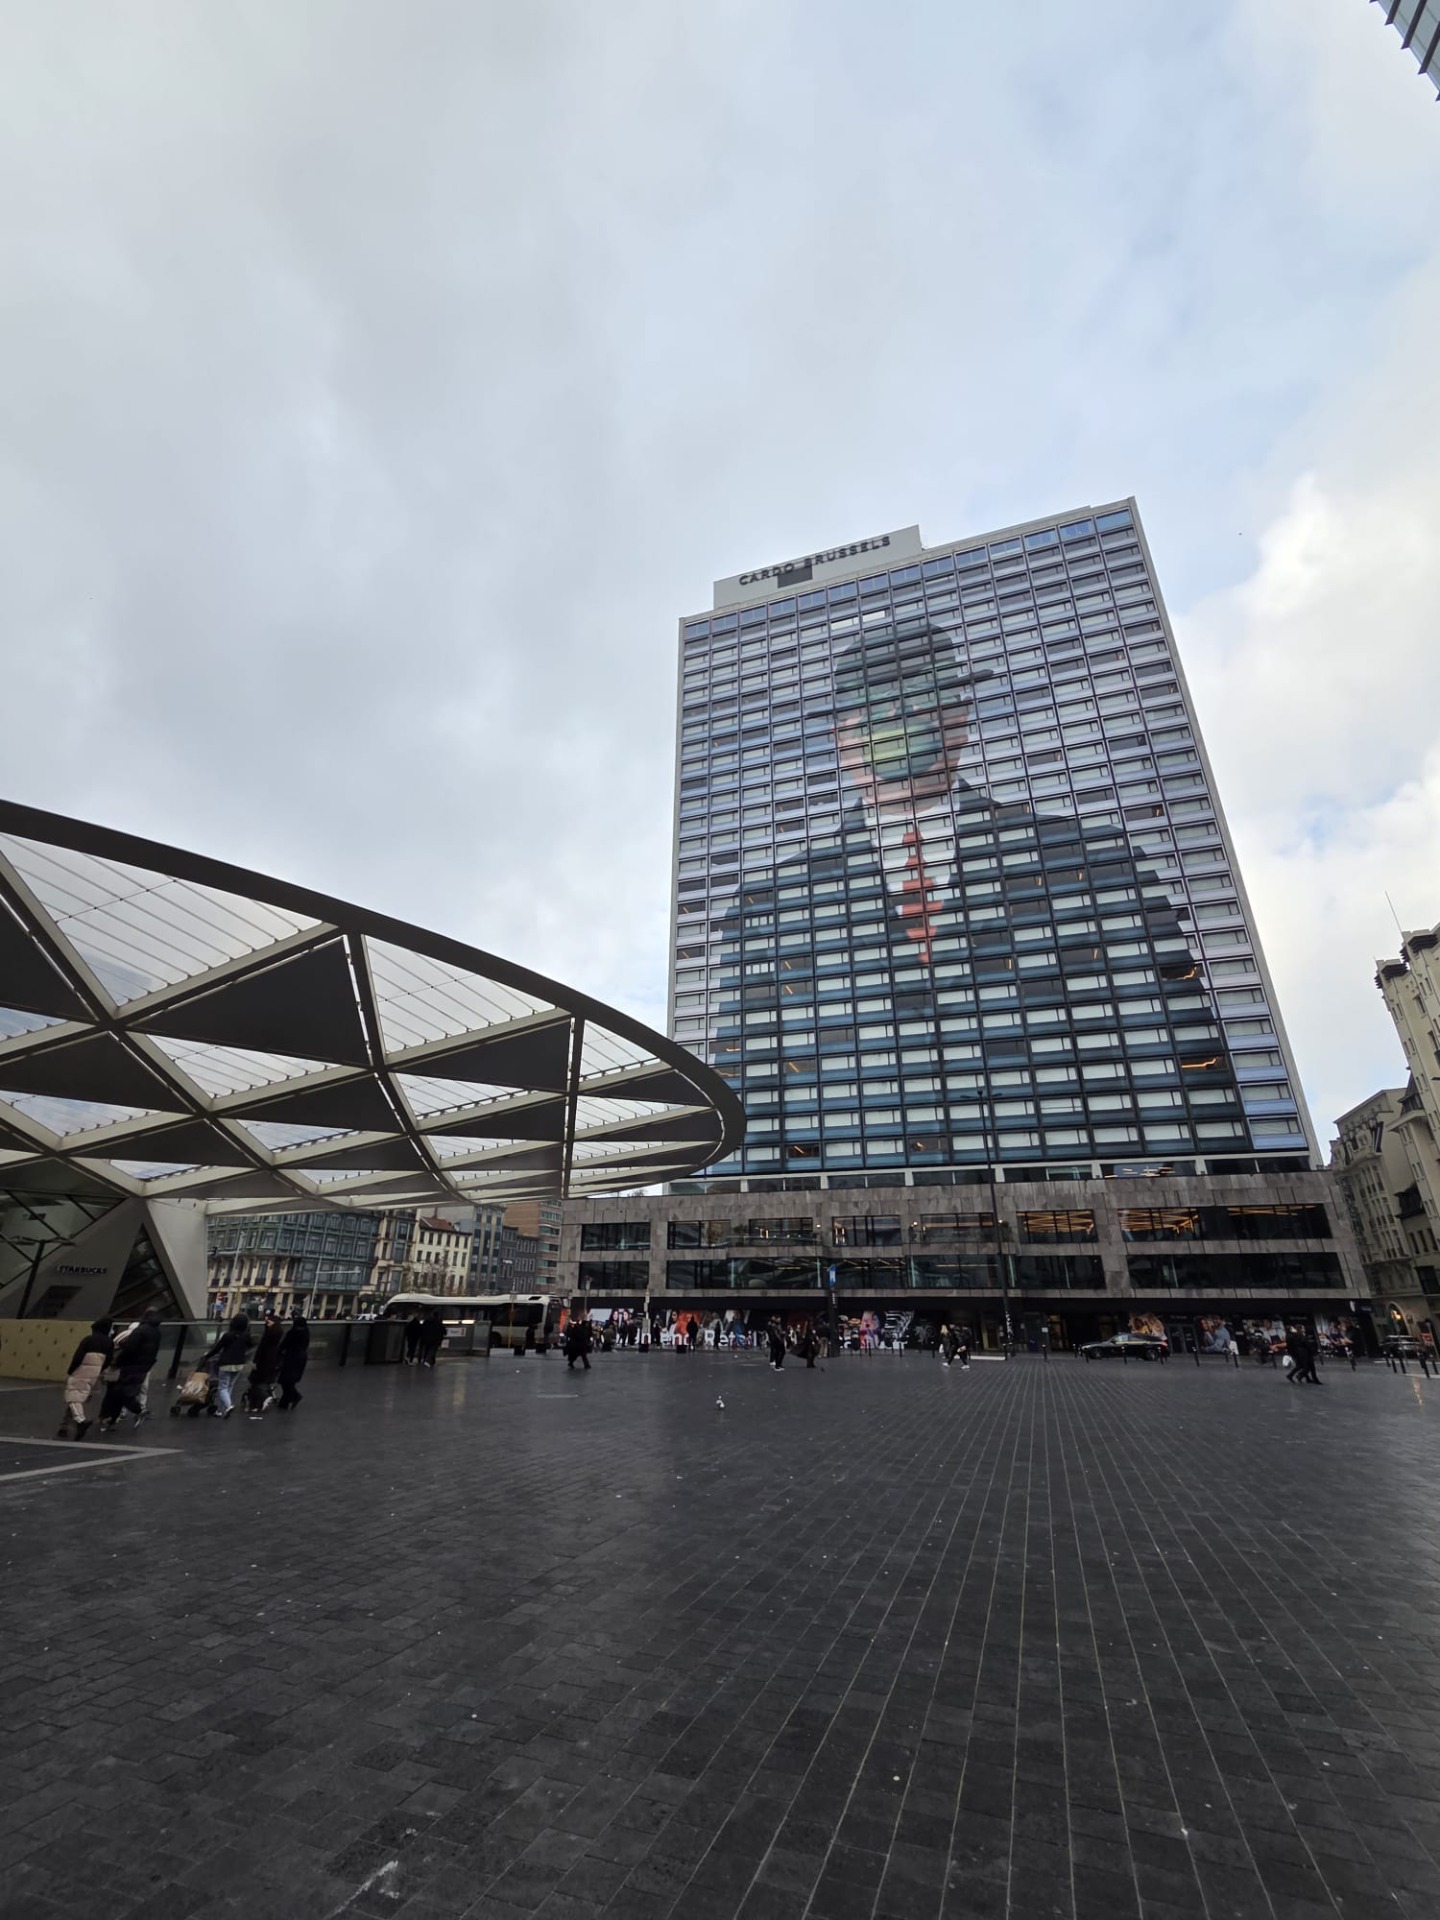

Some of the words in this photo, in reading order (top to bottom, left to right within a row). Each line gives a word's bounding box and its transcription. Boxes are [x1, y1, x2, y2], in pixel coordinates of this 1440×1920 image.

[739, 562, 795, 586] CARDO
[803, 535, 891, 568] BRUSSELS
[58, 1265, 107, 1275] STARBUCKS
